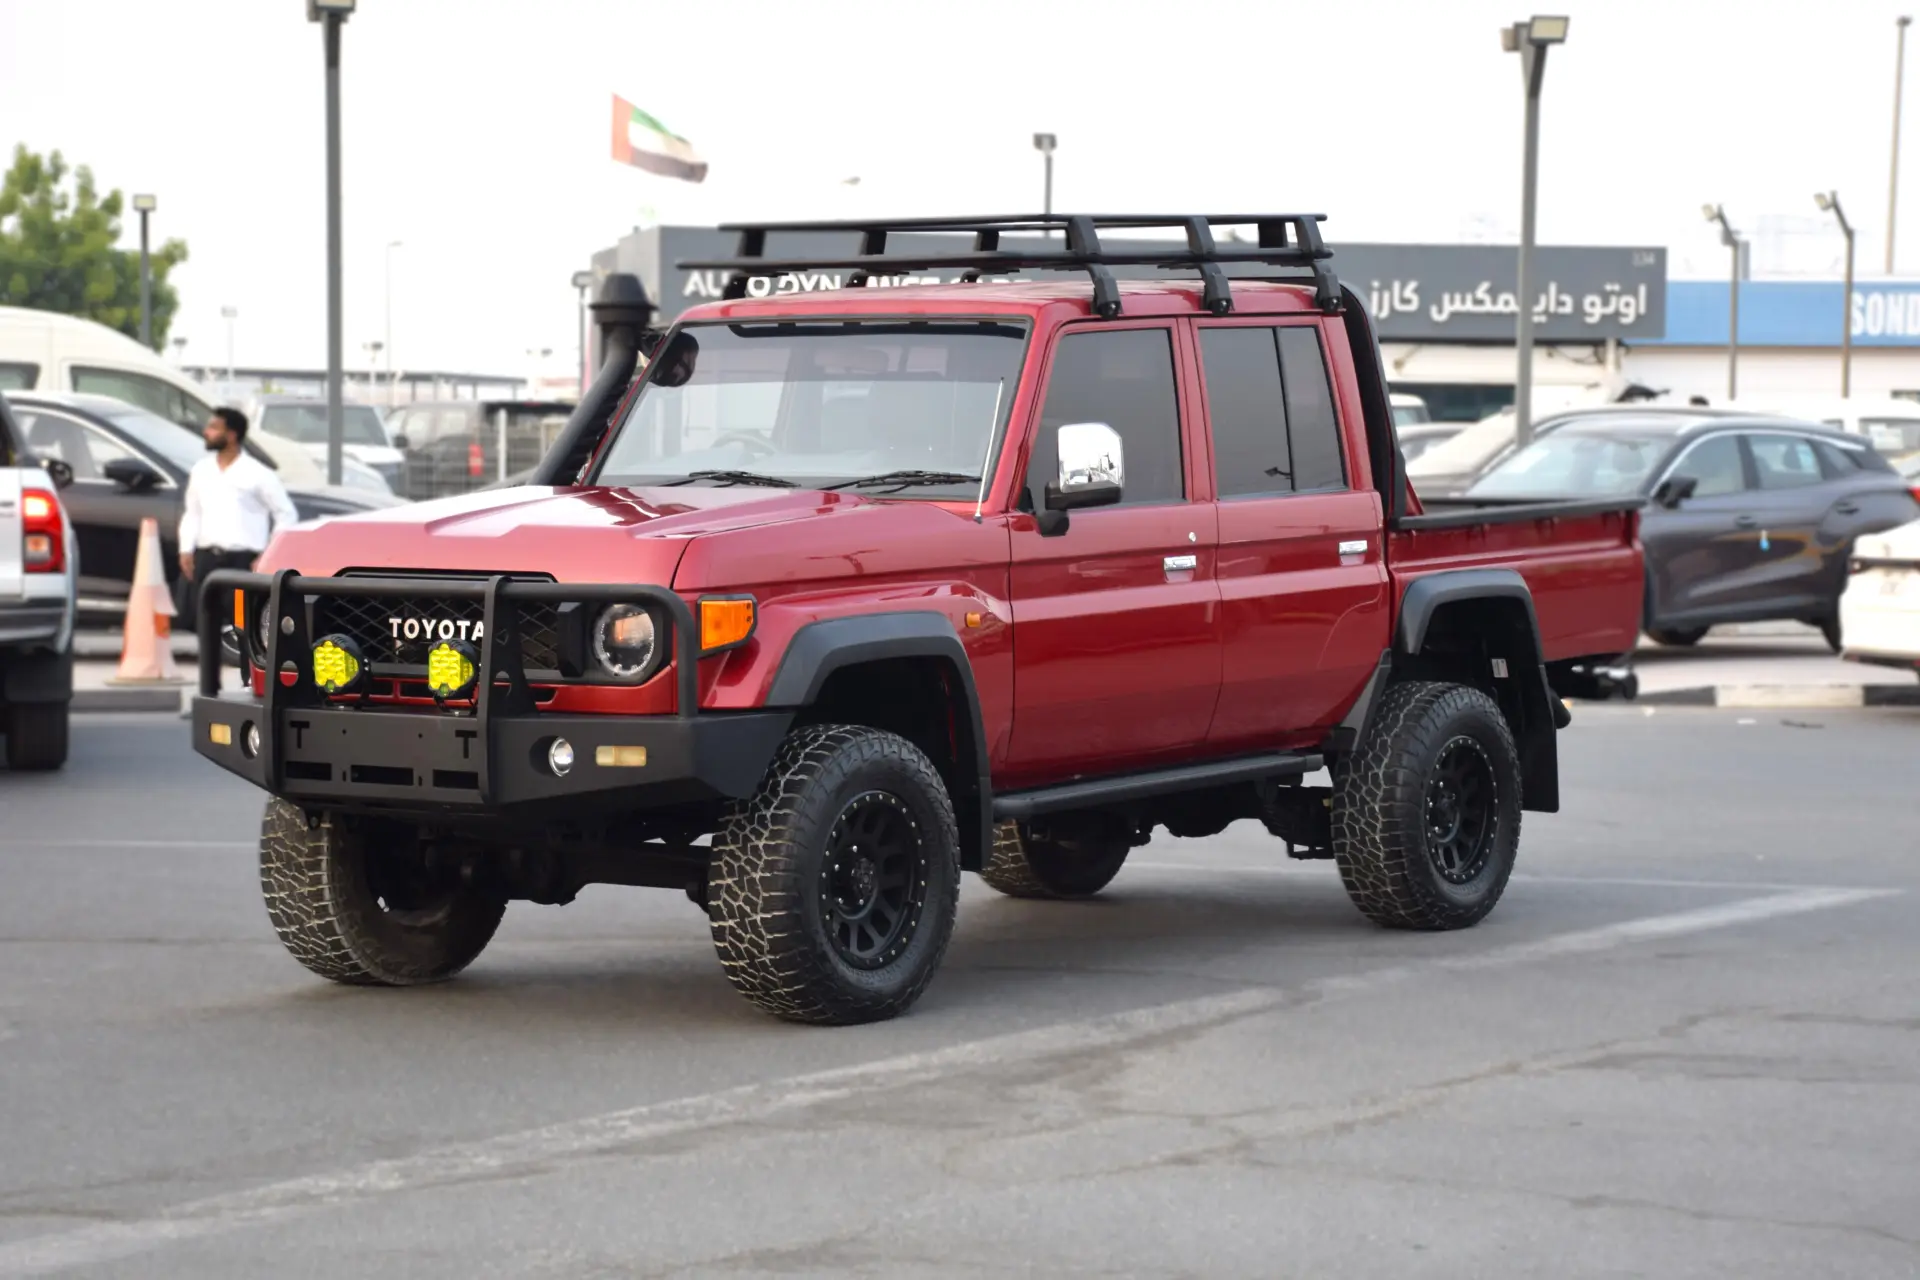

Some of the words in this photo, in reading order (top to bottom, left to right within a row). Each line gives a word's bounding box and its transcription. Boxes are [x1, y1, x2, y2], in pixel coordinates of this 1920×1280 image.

[683, 270, 771, 298] AUO
[1429, 281, 1574, 323] دايمكس
[1583, 281, 1647, 324] اوتو
[388, 618, 485, 641] TOYOTA
